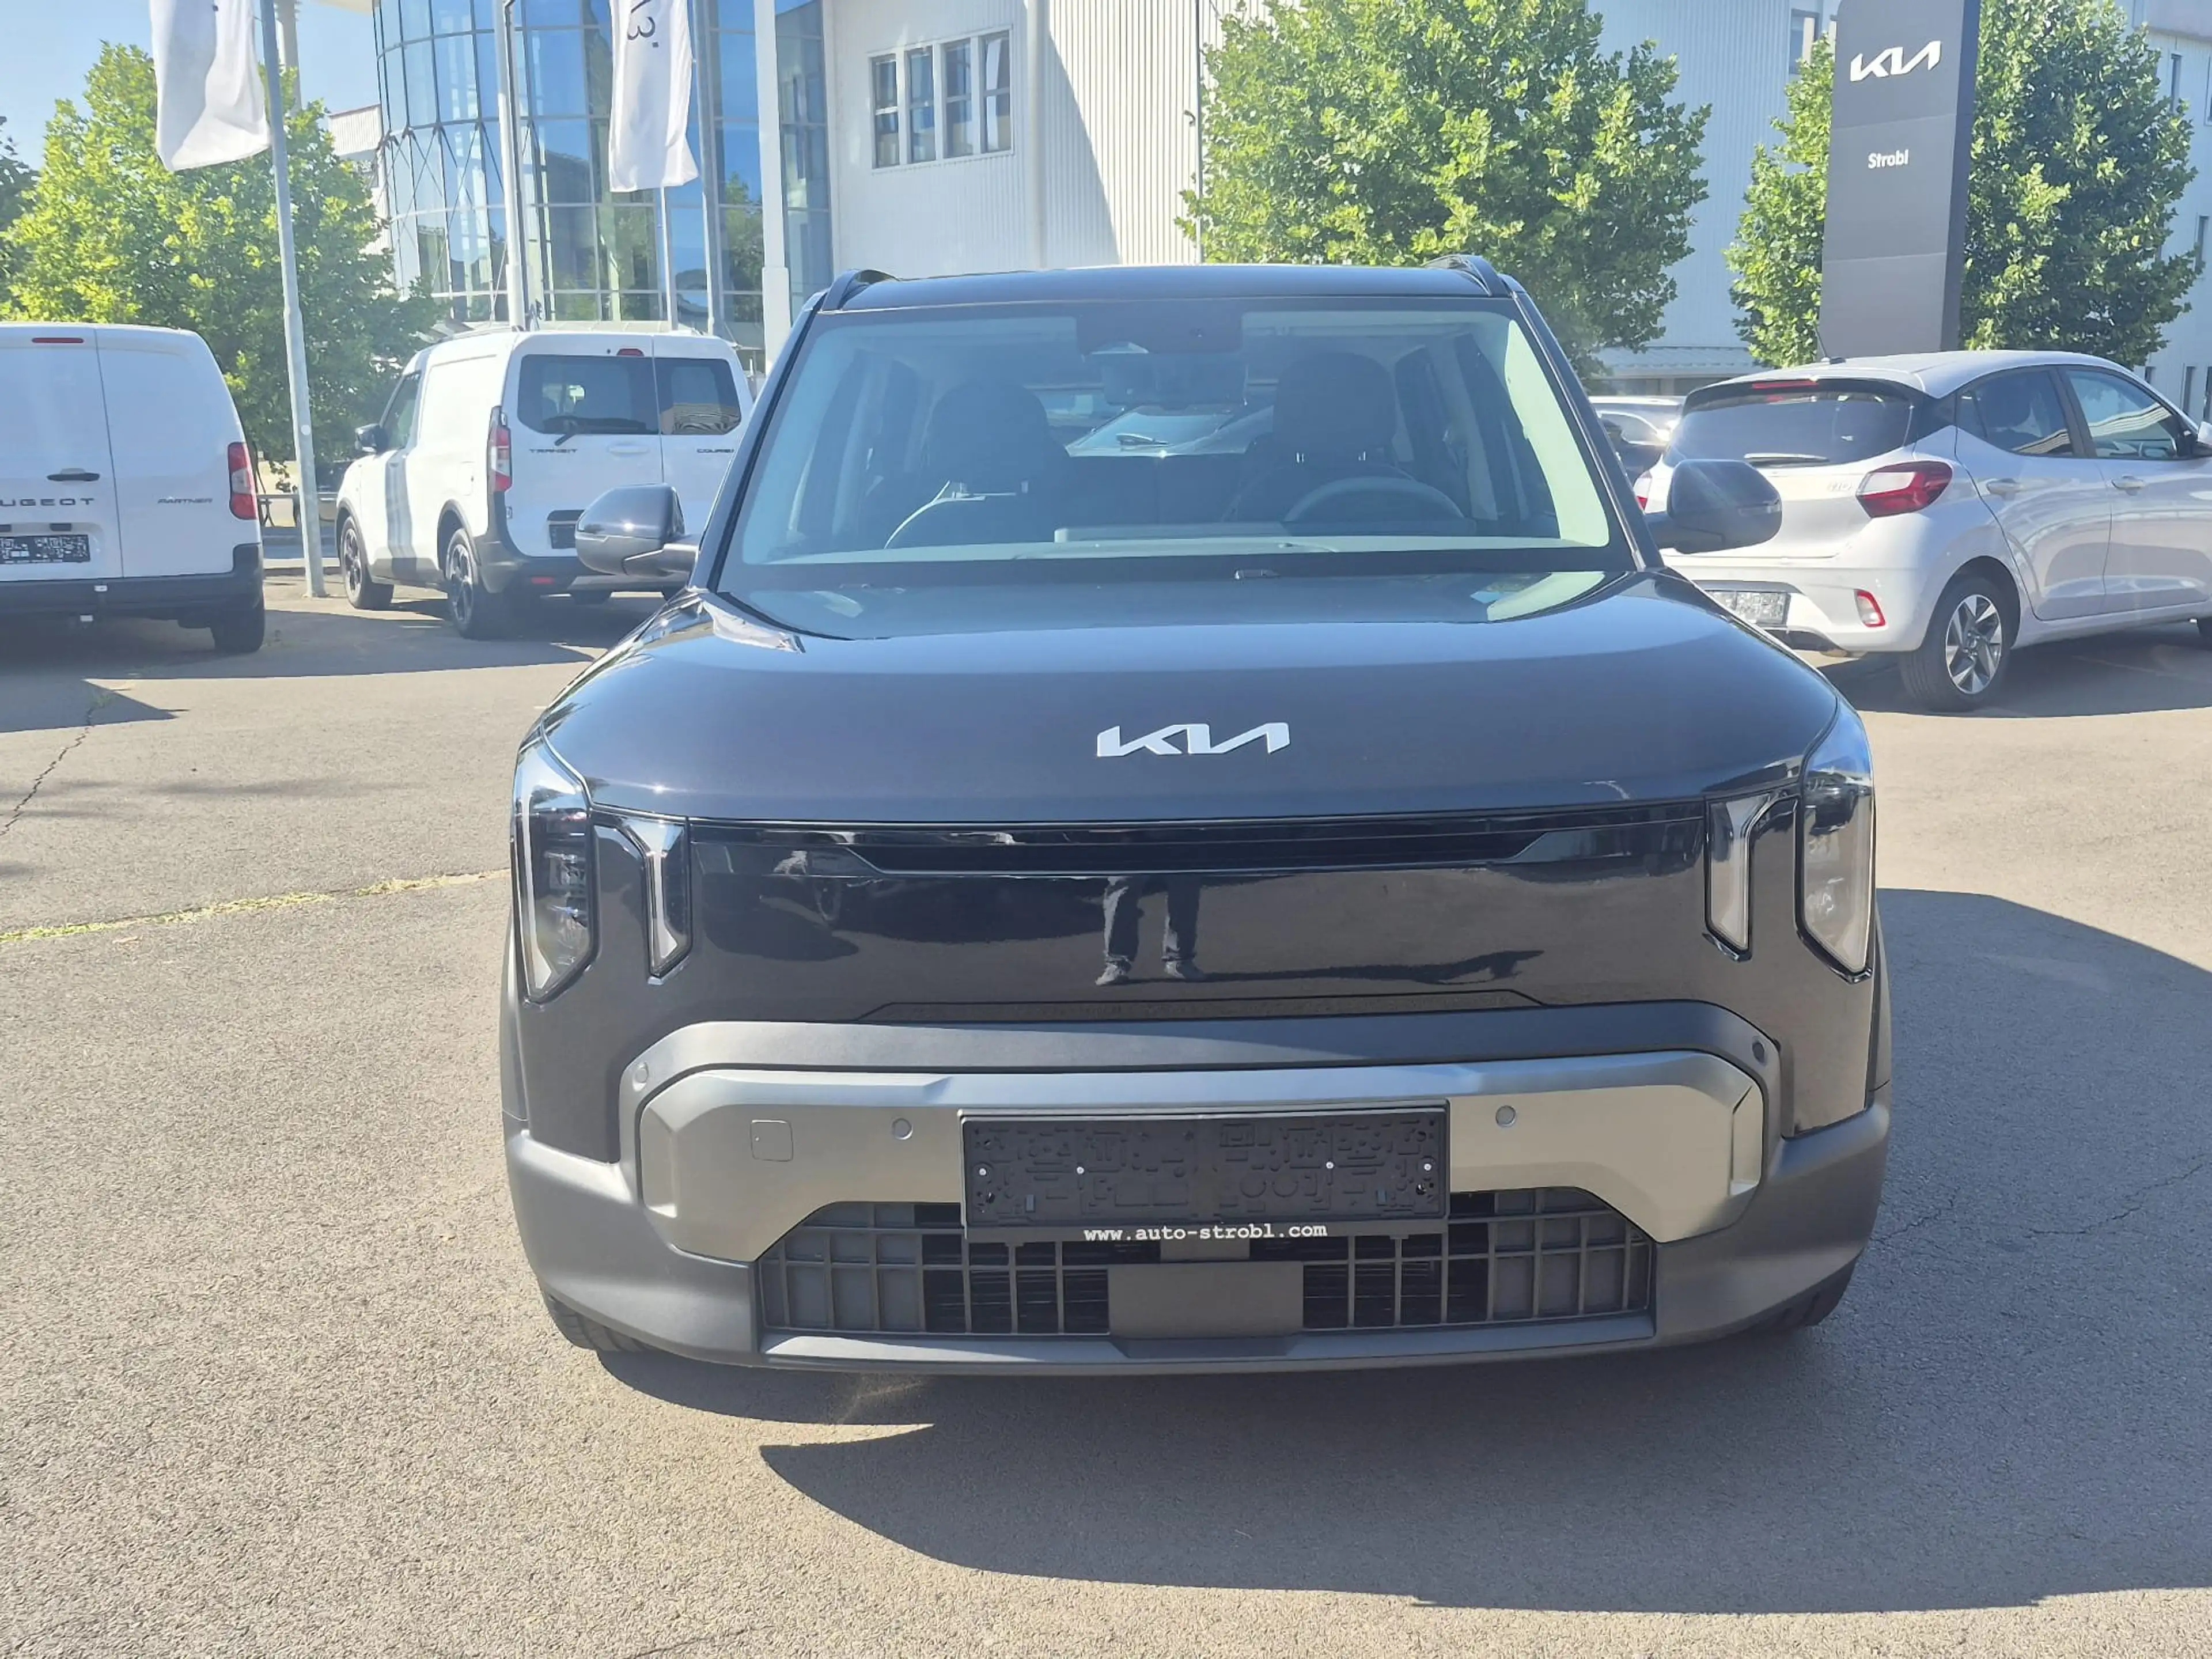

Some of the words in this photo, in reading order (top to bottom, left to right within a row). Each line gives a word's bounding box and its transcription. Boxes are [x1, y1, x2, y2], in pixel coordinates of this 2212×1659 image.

[1850, 40, 1941, 82] KIA
[1868, 149, 1910, 169] Strobl
[1097, 722, 1291, 757] KIA
[1084, 1223, 1328, 1241] www.auto-strobl.com
